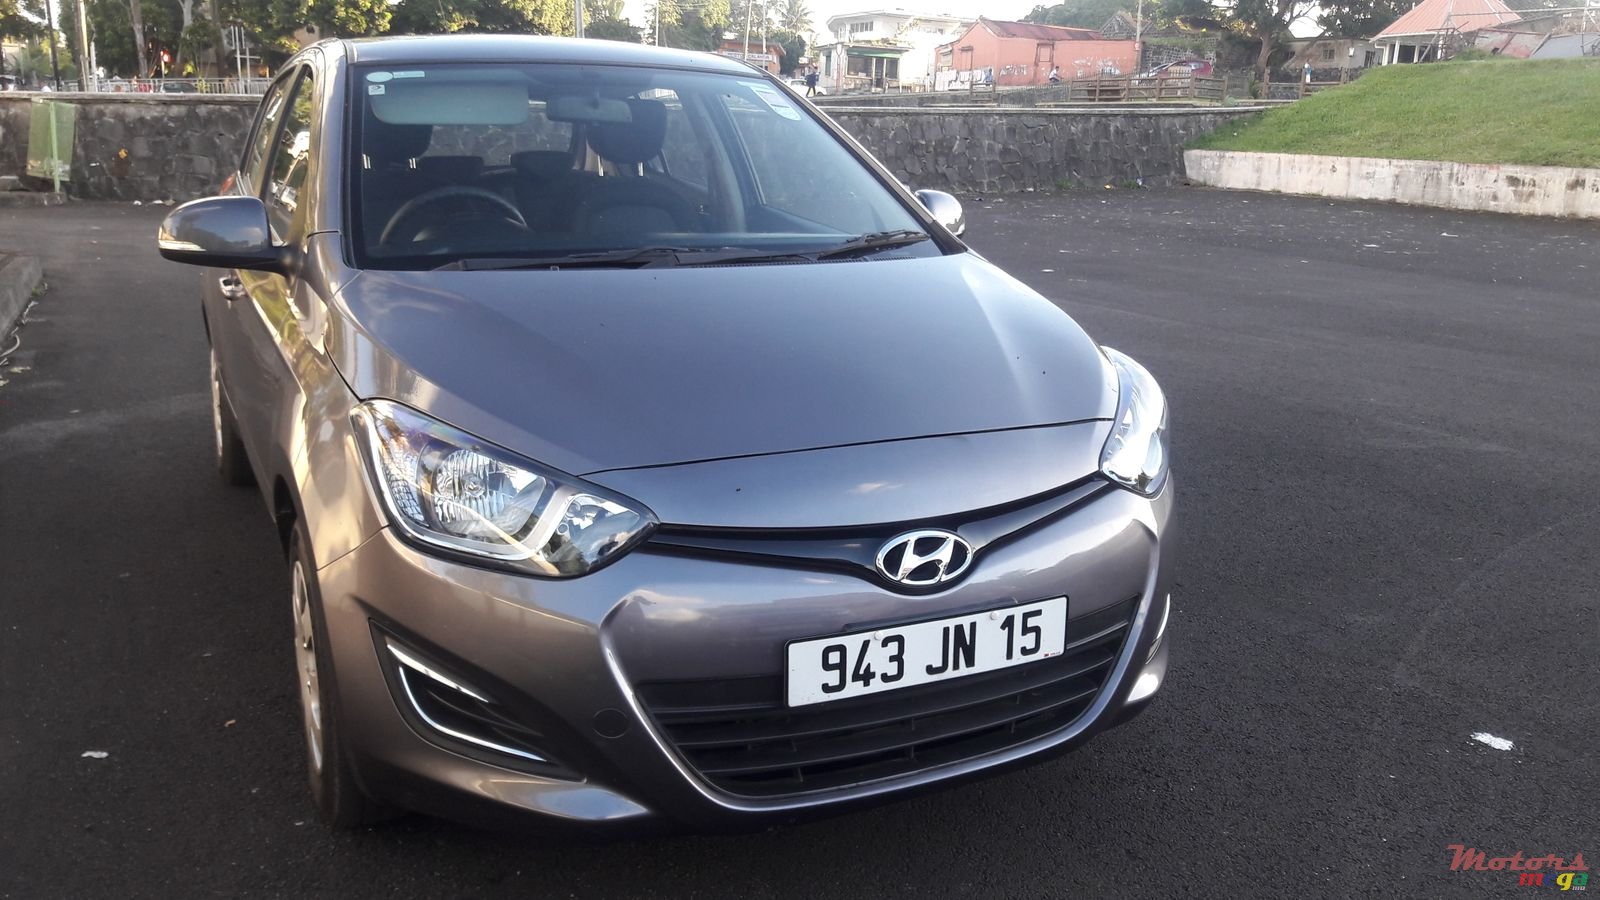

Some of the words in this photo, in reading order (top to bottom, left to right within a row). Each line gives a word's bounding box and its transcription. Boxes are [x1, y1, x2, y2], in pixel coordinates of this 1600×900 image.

[821, 634, 905, 694] 943
[925, 621, 977, 675] JN
[1000, 609, 1043, 660] 15
